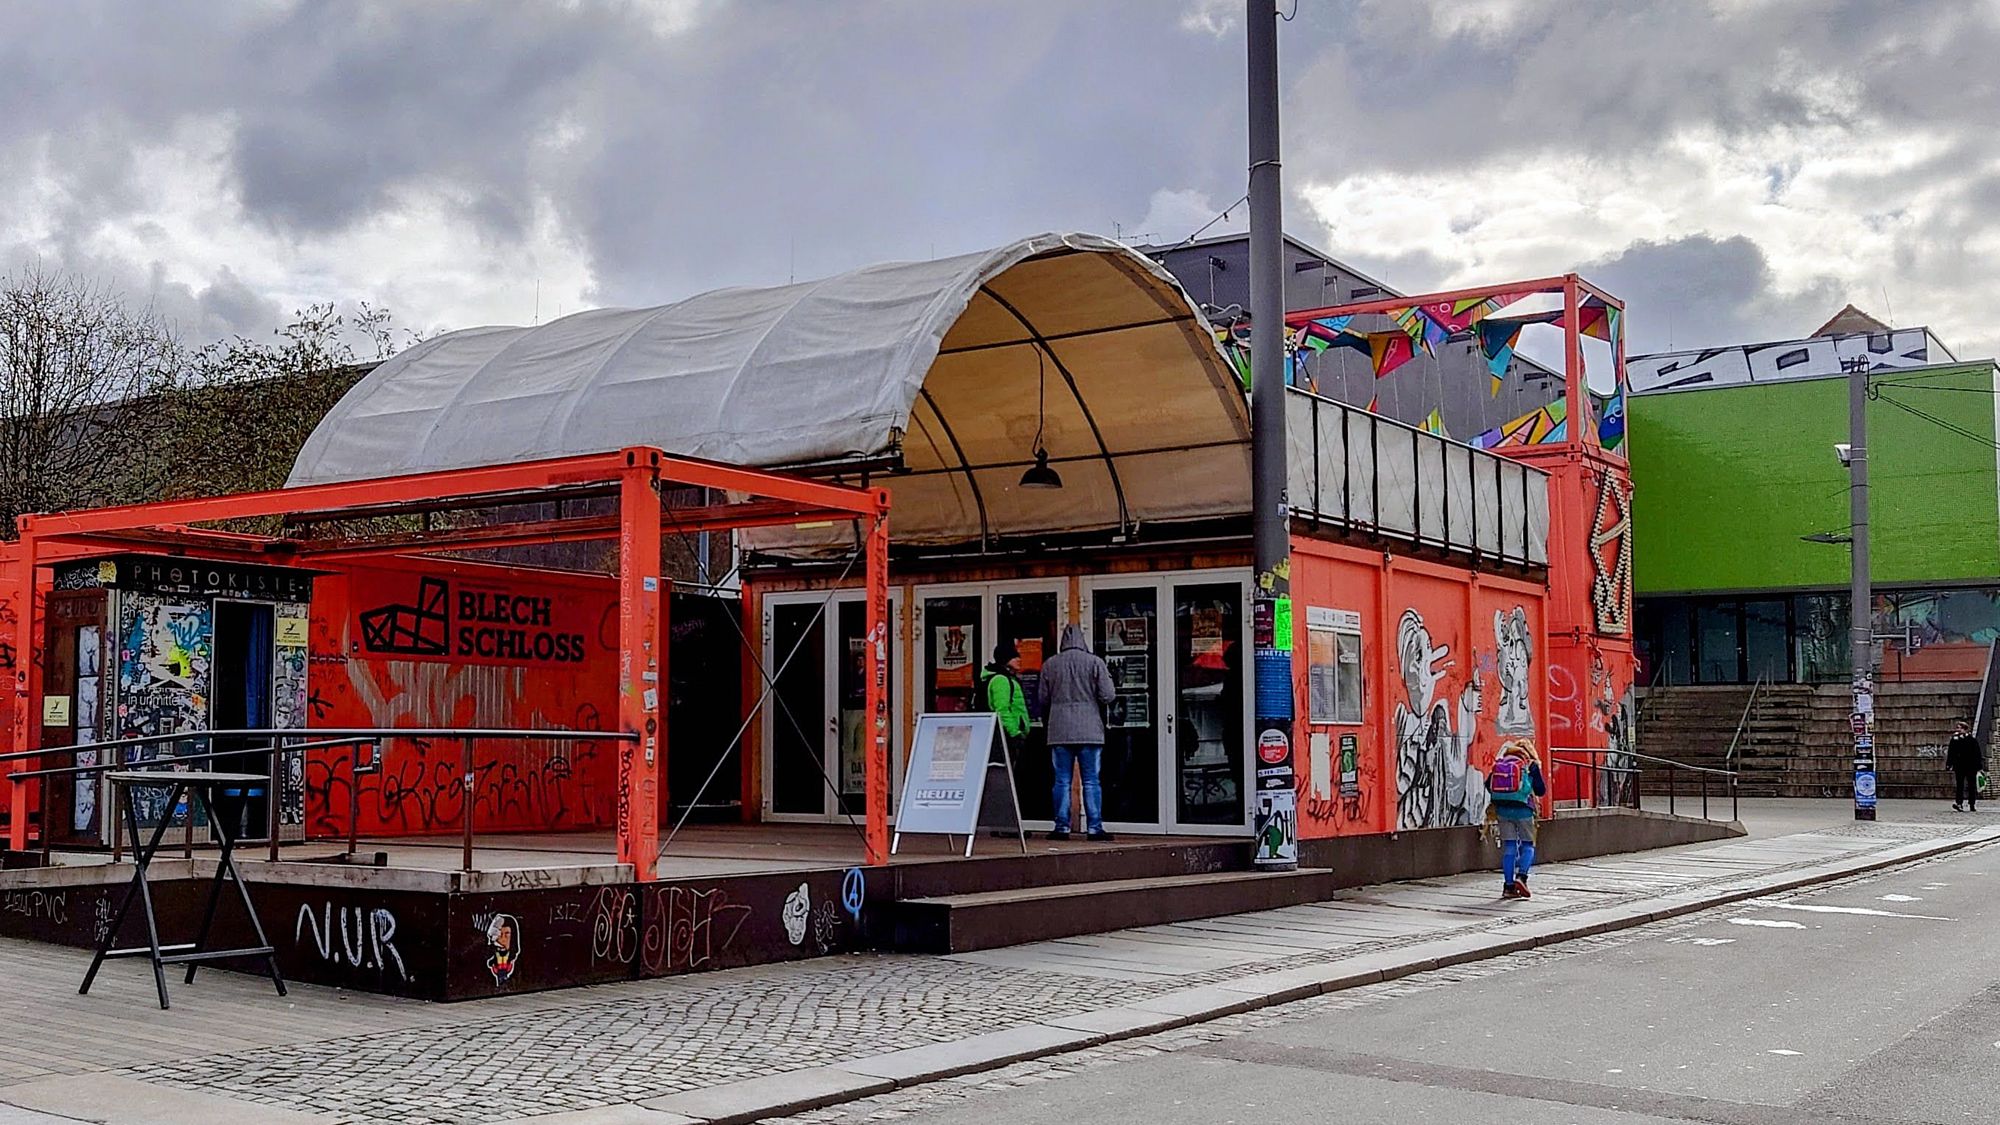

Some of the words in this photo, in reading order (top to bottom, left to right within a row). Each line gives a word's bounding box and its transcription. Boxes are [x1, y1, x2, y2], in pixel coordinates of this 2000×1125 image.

[457, 590, 552, 626] BLECH
[457, 626, 584, 662] SCHLOSS
[916, 789, 965, 800] HEUTE
